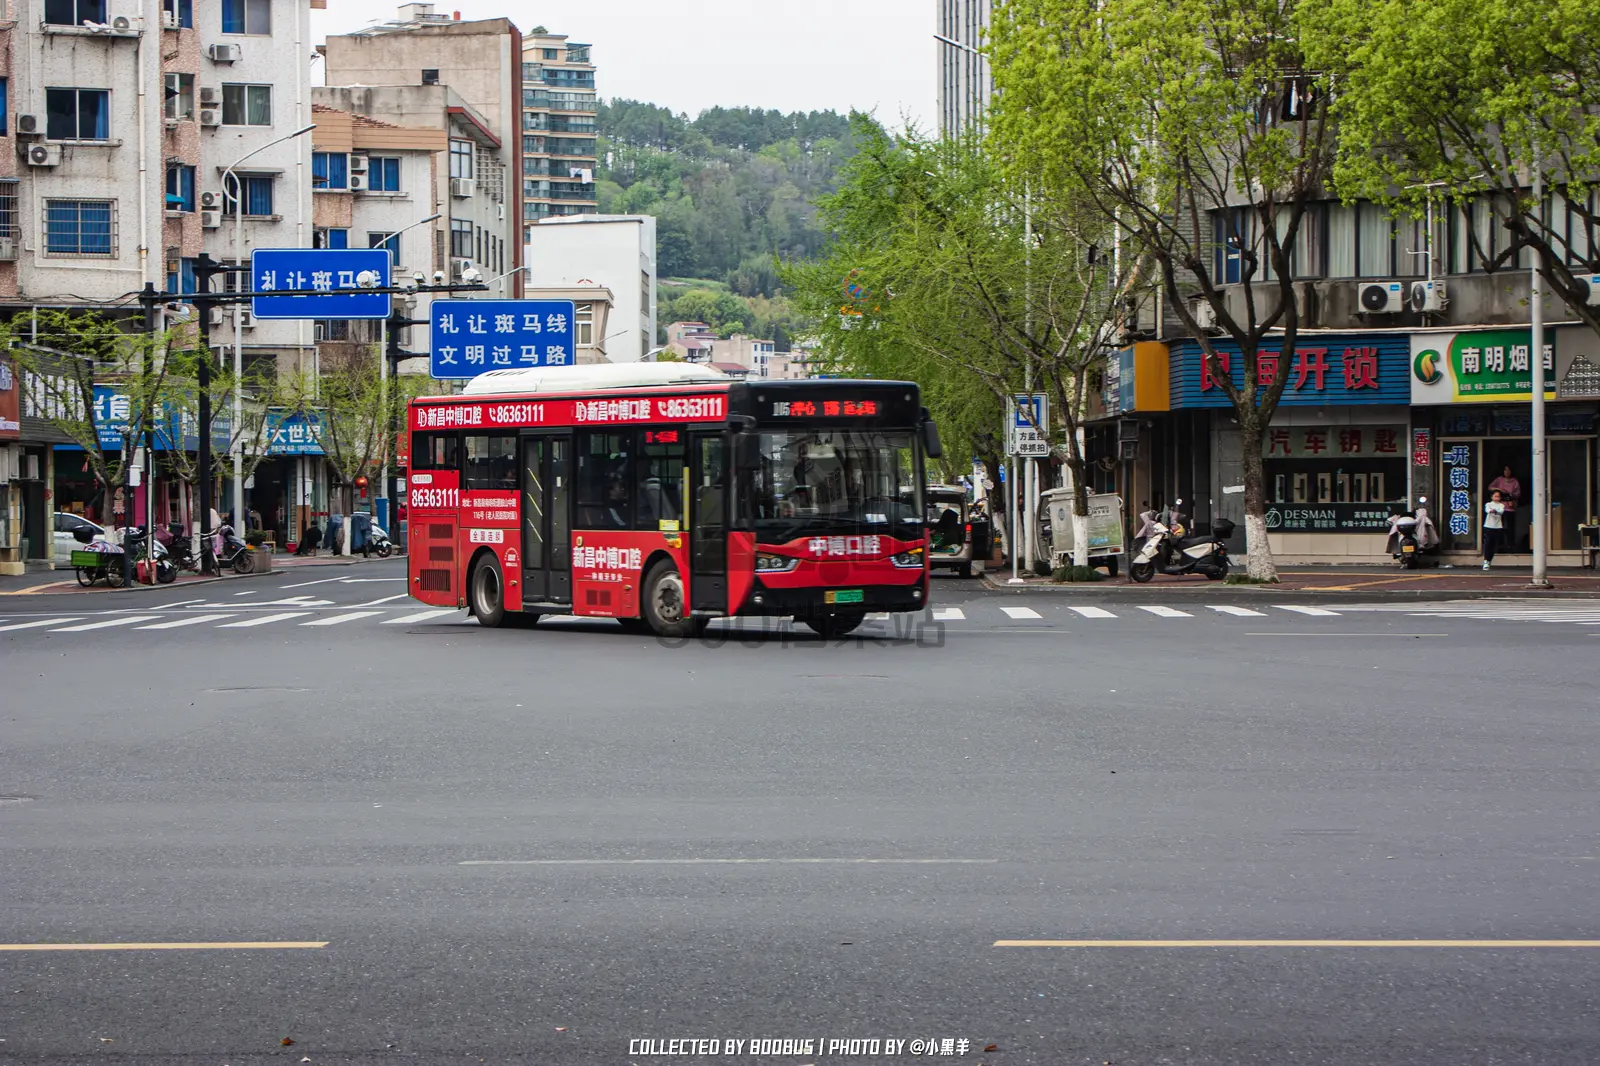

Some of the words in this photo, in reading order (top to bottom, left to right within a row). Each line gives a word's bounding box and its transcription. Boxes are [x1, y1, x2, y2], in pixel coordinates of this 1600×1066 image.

[439, 314, 567, 334] 礼让斑马线
[438, 345, 567, 365] 文明过马路
[428, 405, 482, 427] 新昌中博口腔
[497, 404, 544, 423] 86363111
[587, 399, 651, 421] 新昌中博口腔
[667, 397, 722, 418] 86363111
[1269, 428, 1398, 454] 汽车钥匙
[1413, 431, 1430, 467] 香烟
[411, 488, 459, 507] 86363111
[1450, 445, 1470, 535] 开锁换锁
[1284, 510, 1336, 519] DESMAN
[808, 535, 882, 556] 中博口腔
[573, 546, 642, 569] 新昌中博口腔
